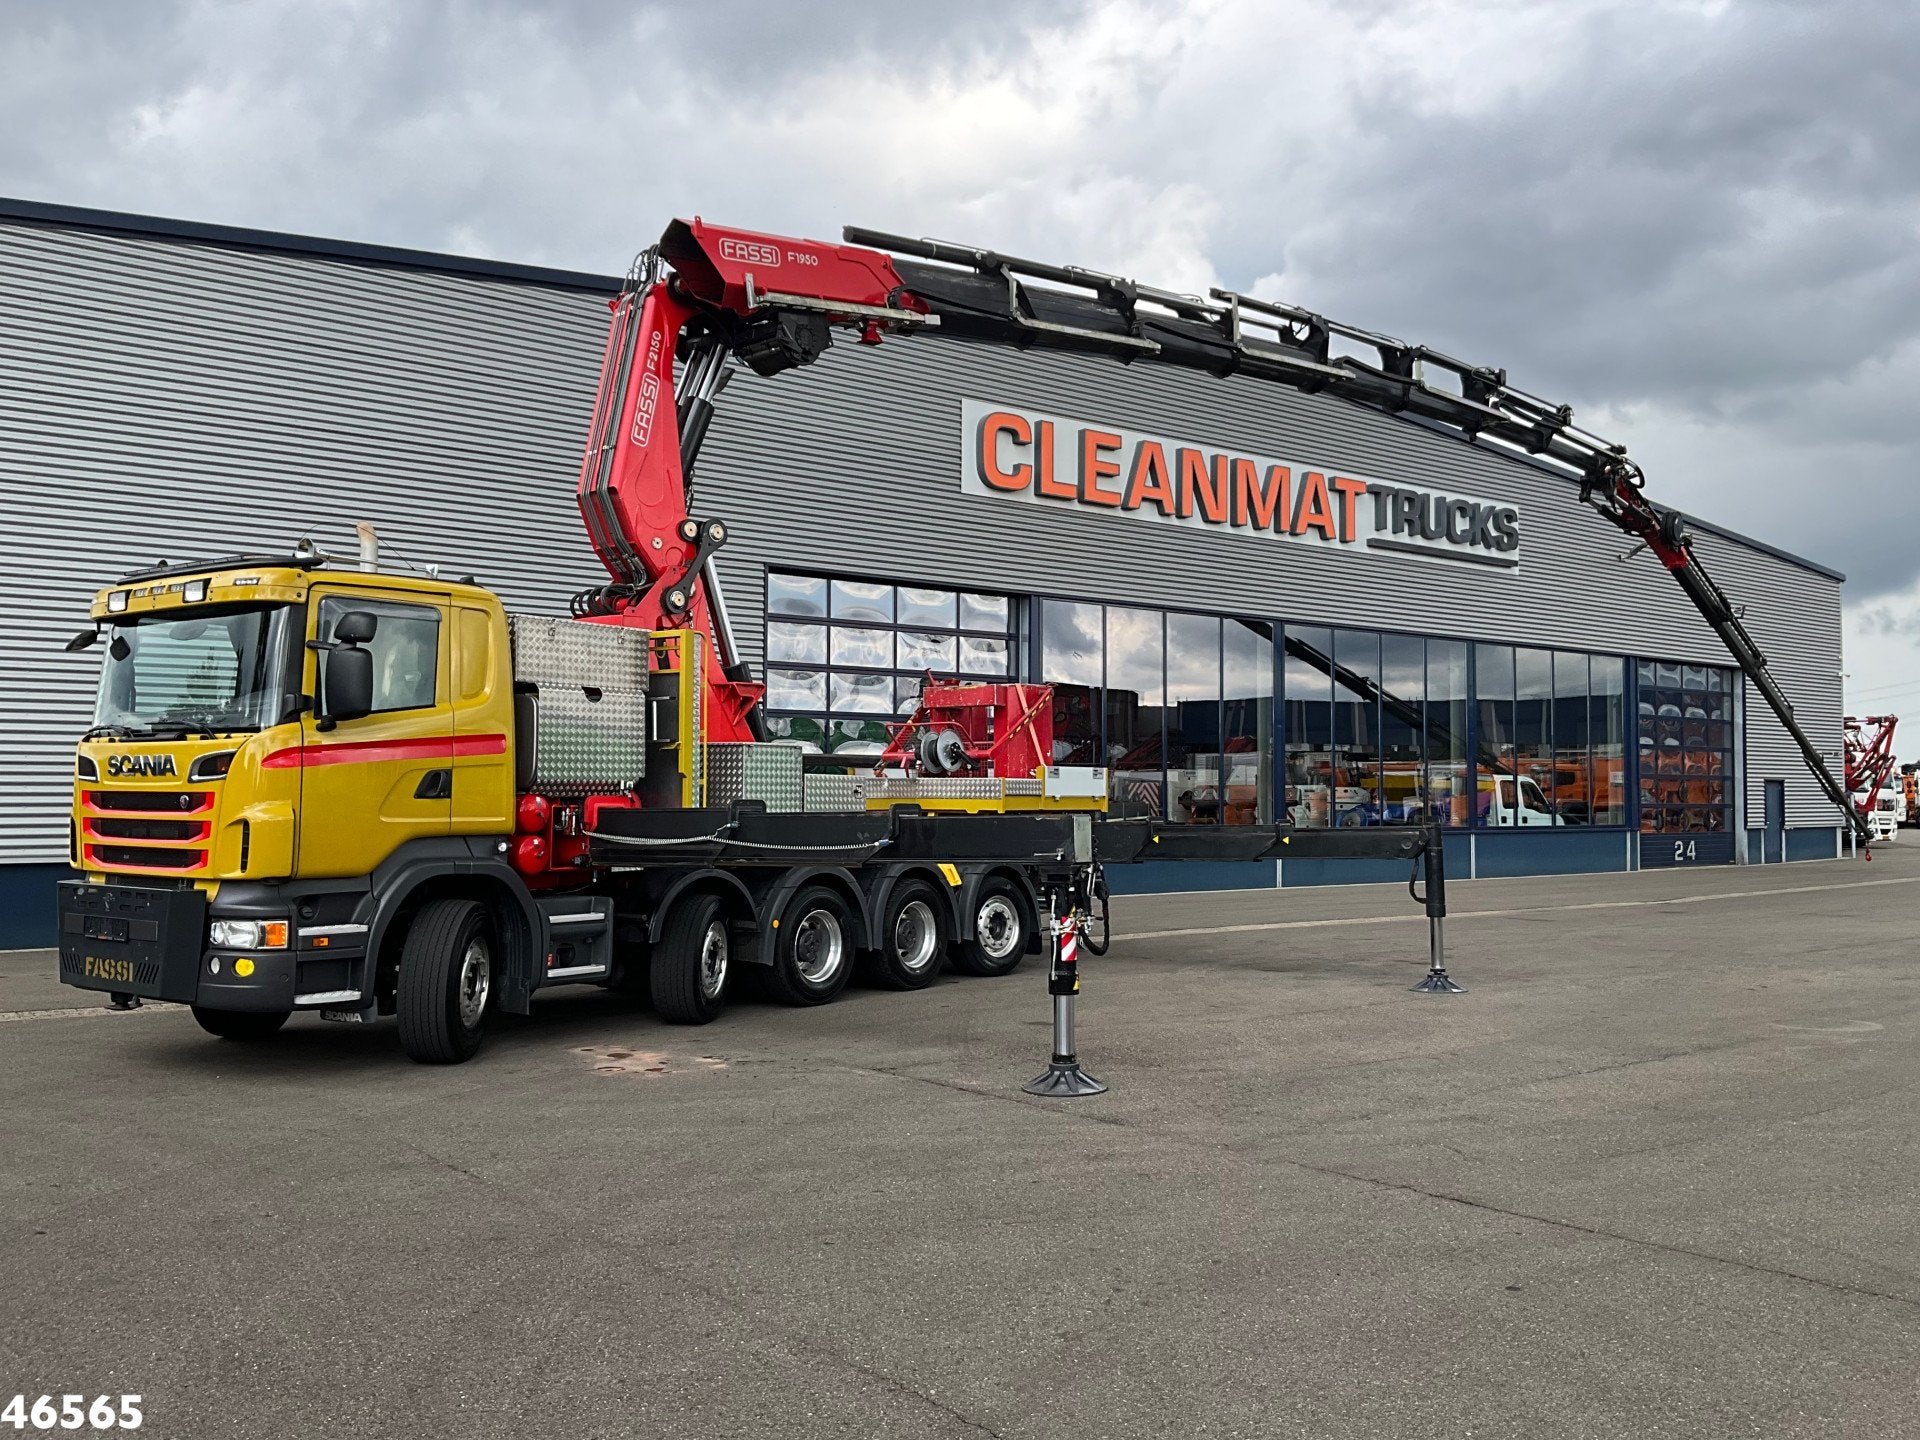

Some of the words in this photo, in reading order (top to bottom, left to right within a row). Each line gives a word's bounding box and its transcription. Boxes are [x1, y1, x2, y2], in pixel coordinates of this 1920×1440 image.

[722, 240, 778, 264] FASSI
[787, 251, 819, 266] F1950
[633, 377, 657, 442] FASSI
[646, 330, 662, 371] F2150
[976, 411, 1366, 543] CLEANMAT
[1367, 483, 1519, 552] TRUCKS
[107, 753, 178, 777] SCANIA
[1674, 840, 1696, 861] 24
[85, 956, 134, 982] FASSI
[324, 1010, 363, 1023] SCANIA
